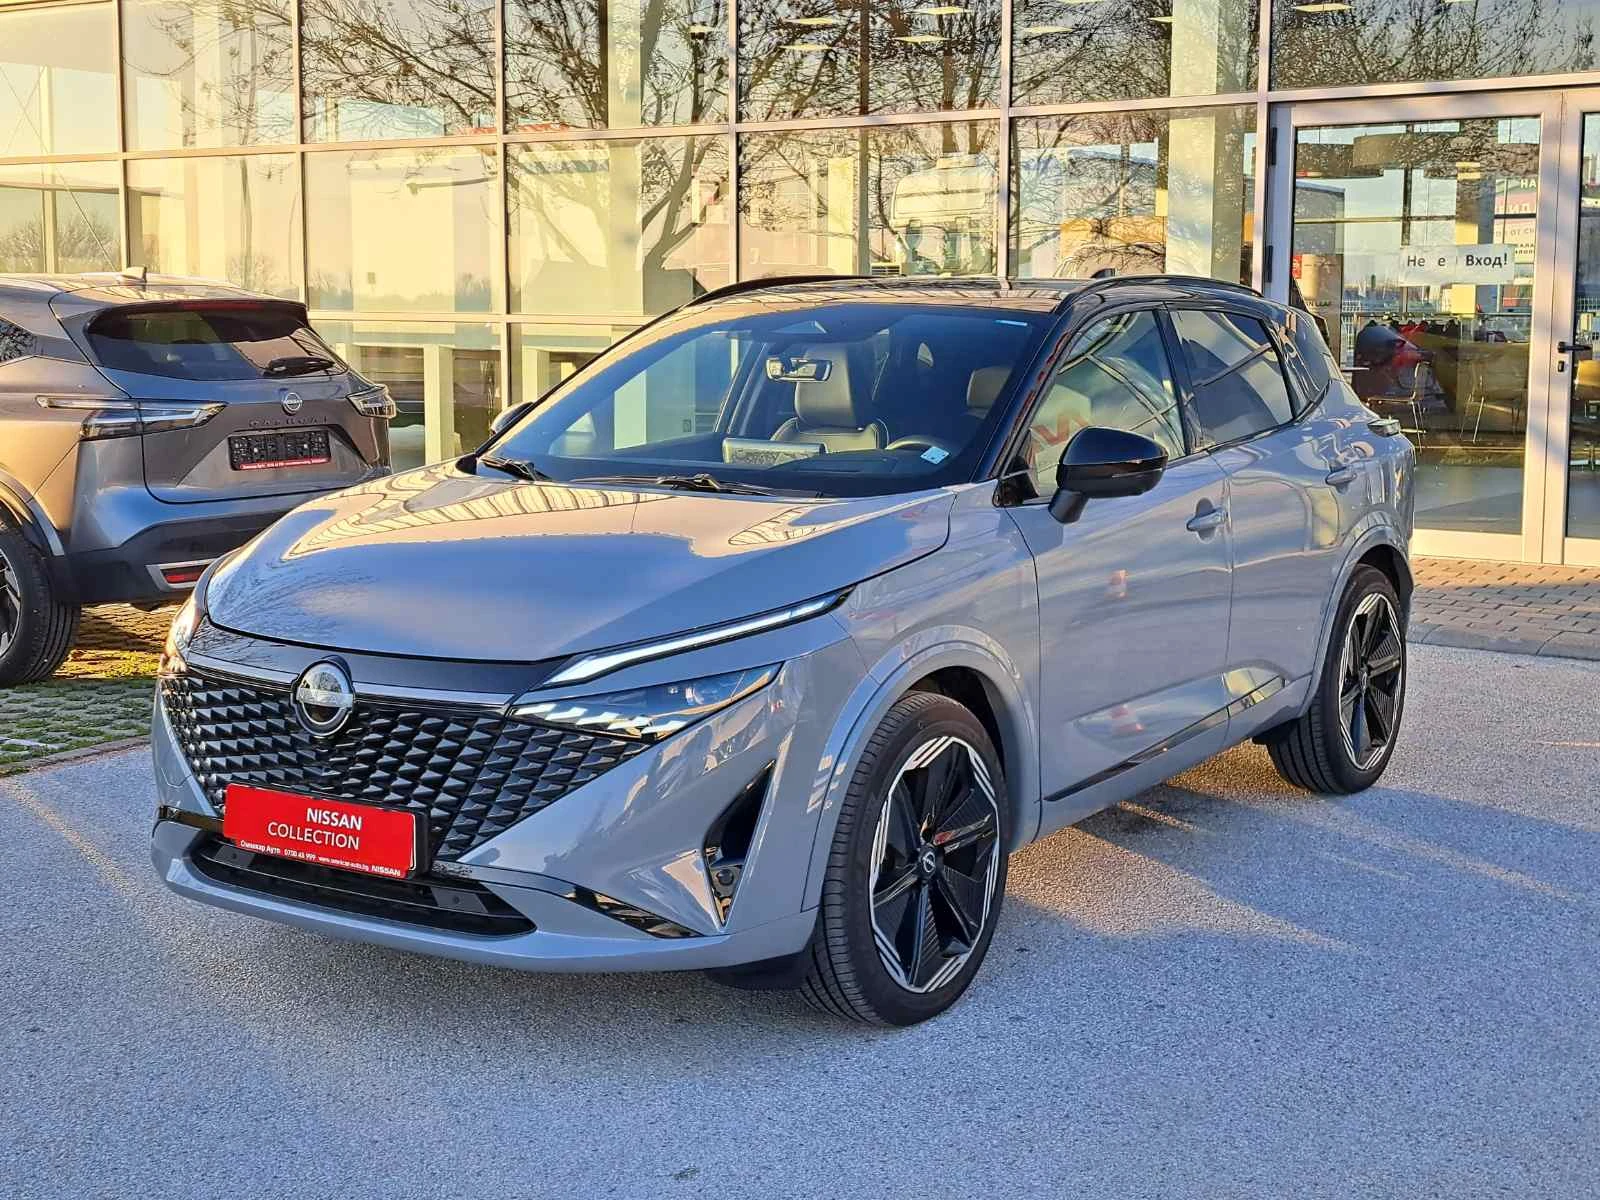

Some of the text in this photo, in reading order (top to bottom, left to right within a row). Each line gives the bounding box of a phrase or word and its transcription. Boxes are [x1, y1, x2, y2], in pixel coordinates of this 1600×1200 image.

[1407, 255, 1426, 267] Не
[1437, 256, 1447, 267] е
[1465, 252, 1508, 269] Вход!
[306, 808, 362, 830] NISSAN
[267, 821, 360, 850] COLLECTION
[371, 865, 400, 876] NISSAN
